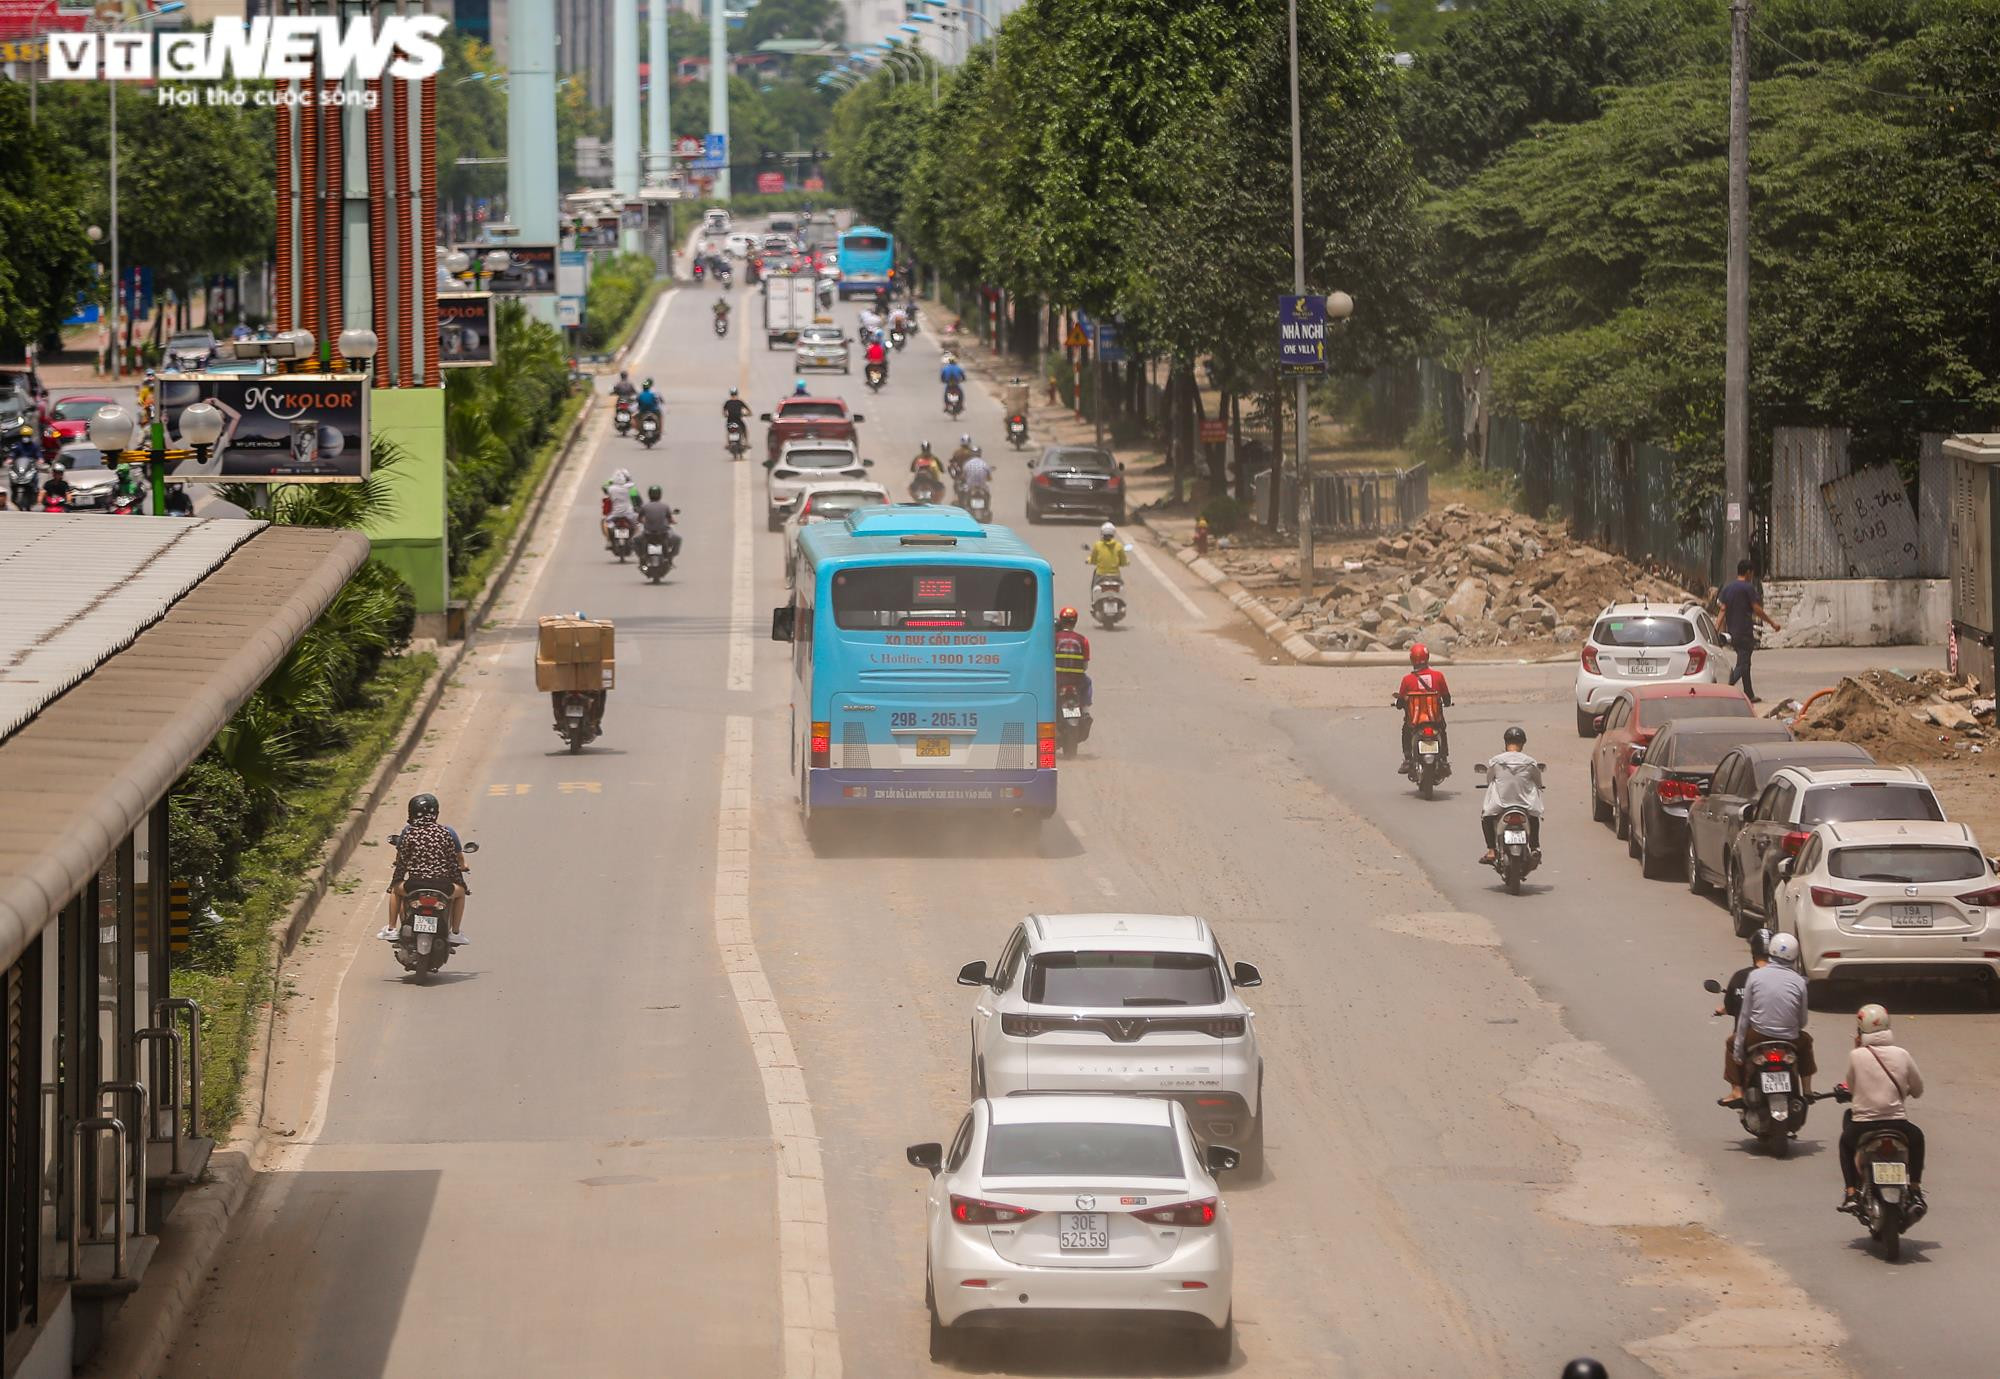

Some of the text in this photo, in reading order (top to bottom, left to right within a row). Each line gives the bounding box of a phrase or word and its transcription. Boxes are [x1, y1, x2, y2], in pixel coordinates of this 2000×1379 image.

[1282, 318, 1324, 340] NHÀ NGHỈ
[1283, 344, 1316, 354] ONE VILLA
[931, 654, 964, 665] 1900
[891, 711, 917, 727] 29B
[931, 711, 978, 727] 205.15
[1903, 906, 1921, 915] 19A
[1071, 1215, 1097, 1231] 30E
[1061, 1232, 1107, 1248] 525.59
